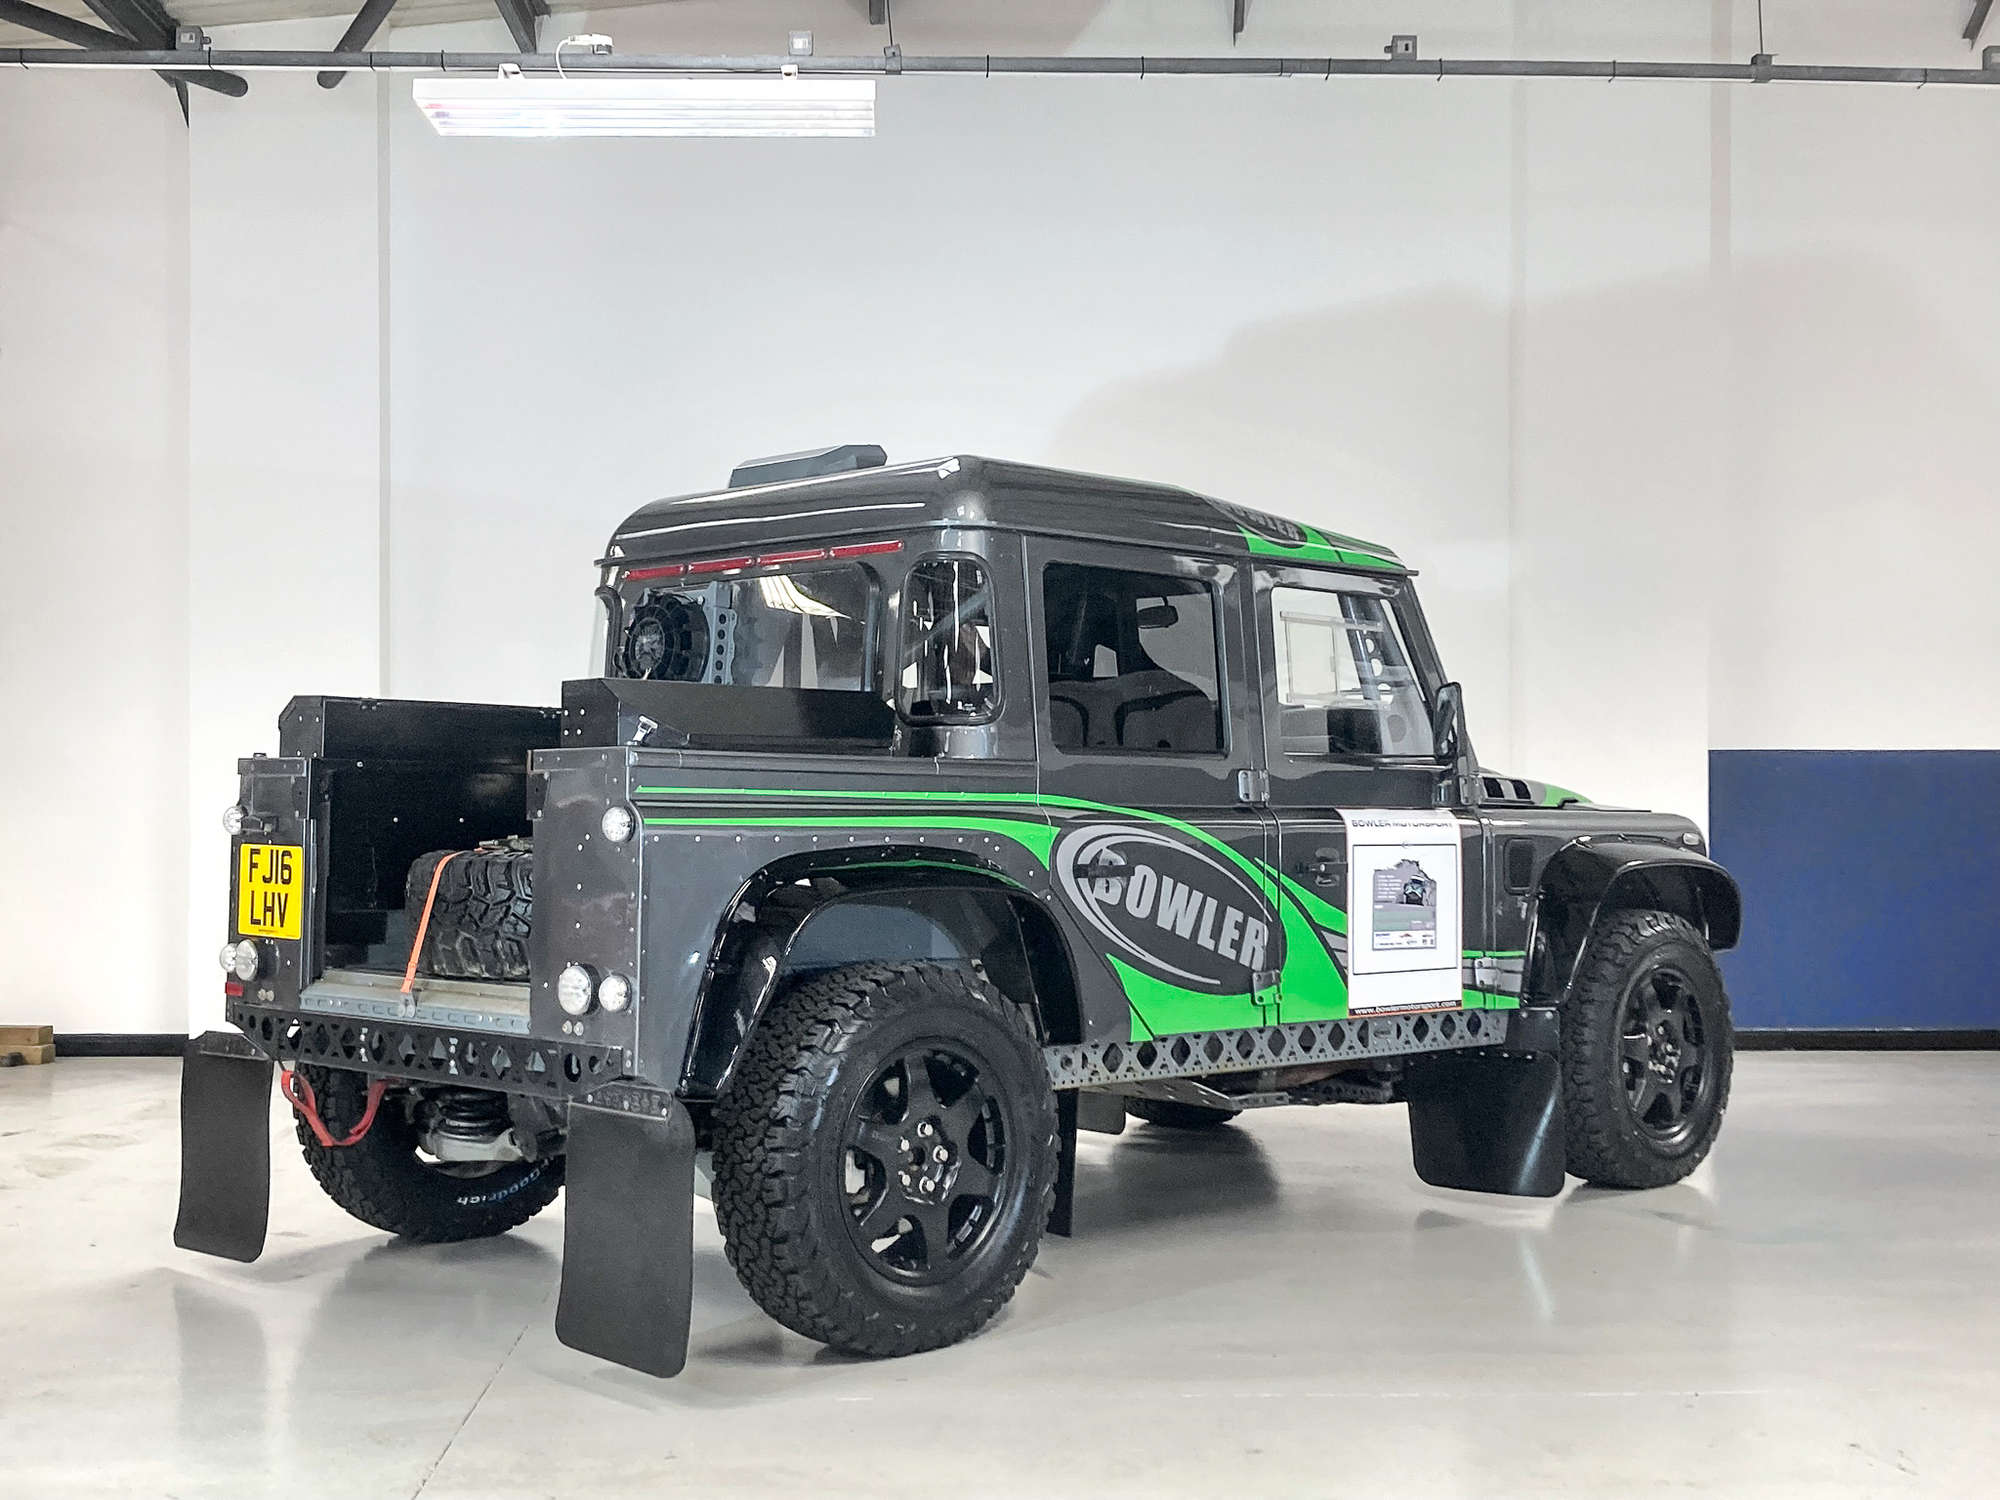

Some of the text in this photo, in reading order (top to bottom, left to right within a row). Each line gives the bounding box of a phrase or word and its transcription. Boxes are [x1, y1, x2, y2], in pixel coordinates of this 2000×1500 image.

[249, 848, 292, 885] FJ16
[250, 890, 289, 928] LHV
[1094, 848, 1268, 971] BOWLER
